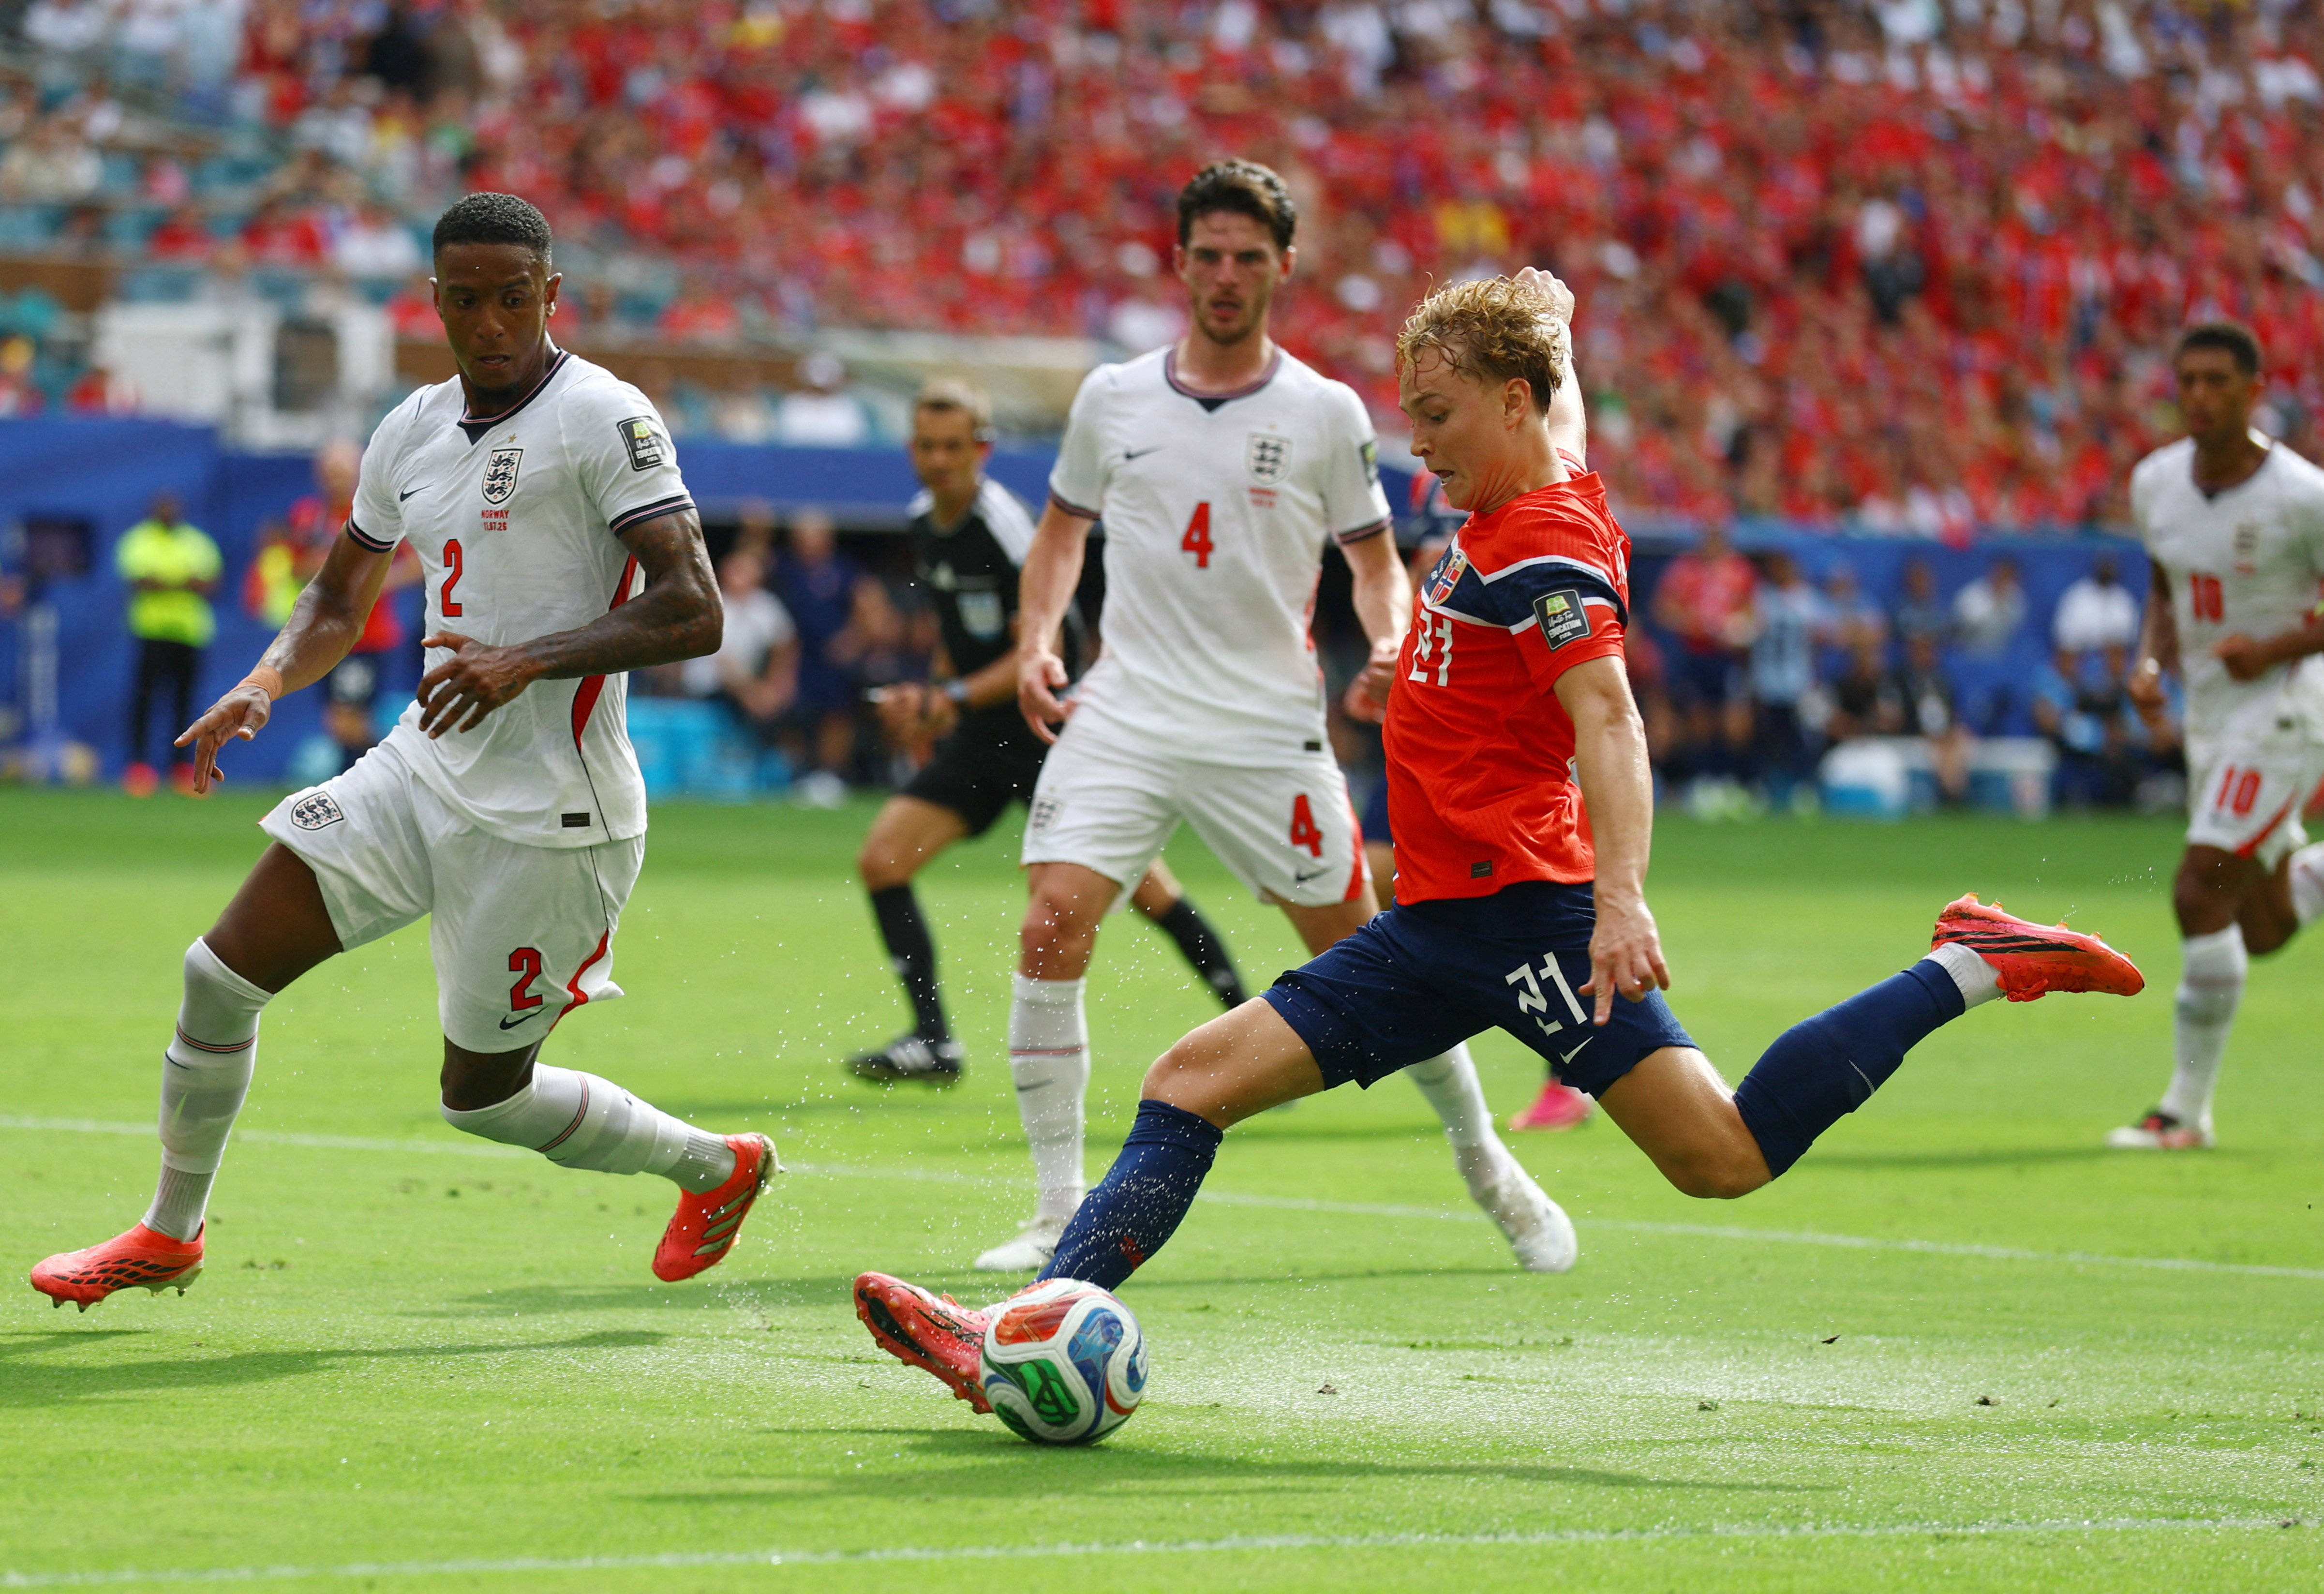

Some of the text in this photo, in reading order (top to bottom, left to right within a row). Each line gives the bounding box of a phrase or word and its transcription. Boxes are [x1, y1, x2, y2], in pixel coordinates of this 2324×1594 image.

[481, 509, 509, 519] NORWAY
[1182, 502, 1214, 568] 4
[441, 538, 462, 617] 2
[2190, 571, 2224, 623] 10
[1408, 608, 1453, 687] 21
[1548, 619, 1582, 639] EDUCATION
[1559, 631, 1573, 640] FIFA
[2217, 764, 2262, 815] 10
[1291, 794, 1323, 858] 4
[509, 947, 542, 1012] 2
[1505, 951, 1588, 1036] 21
